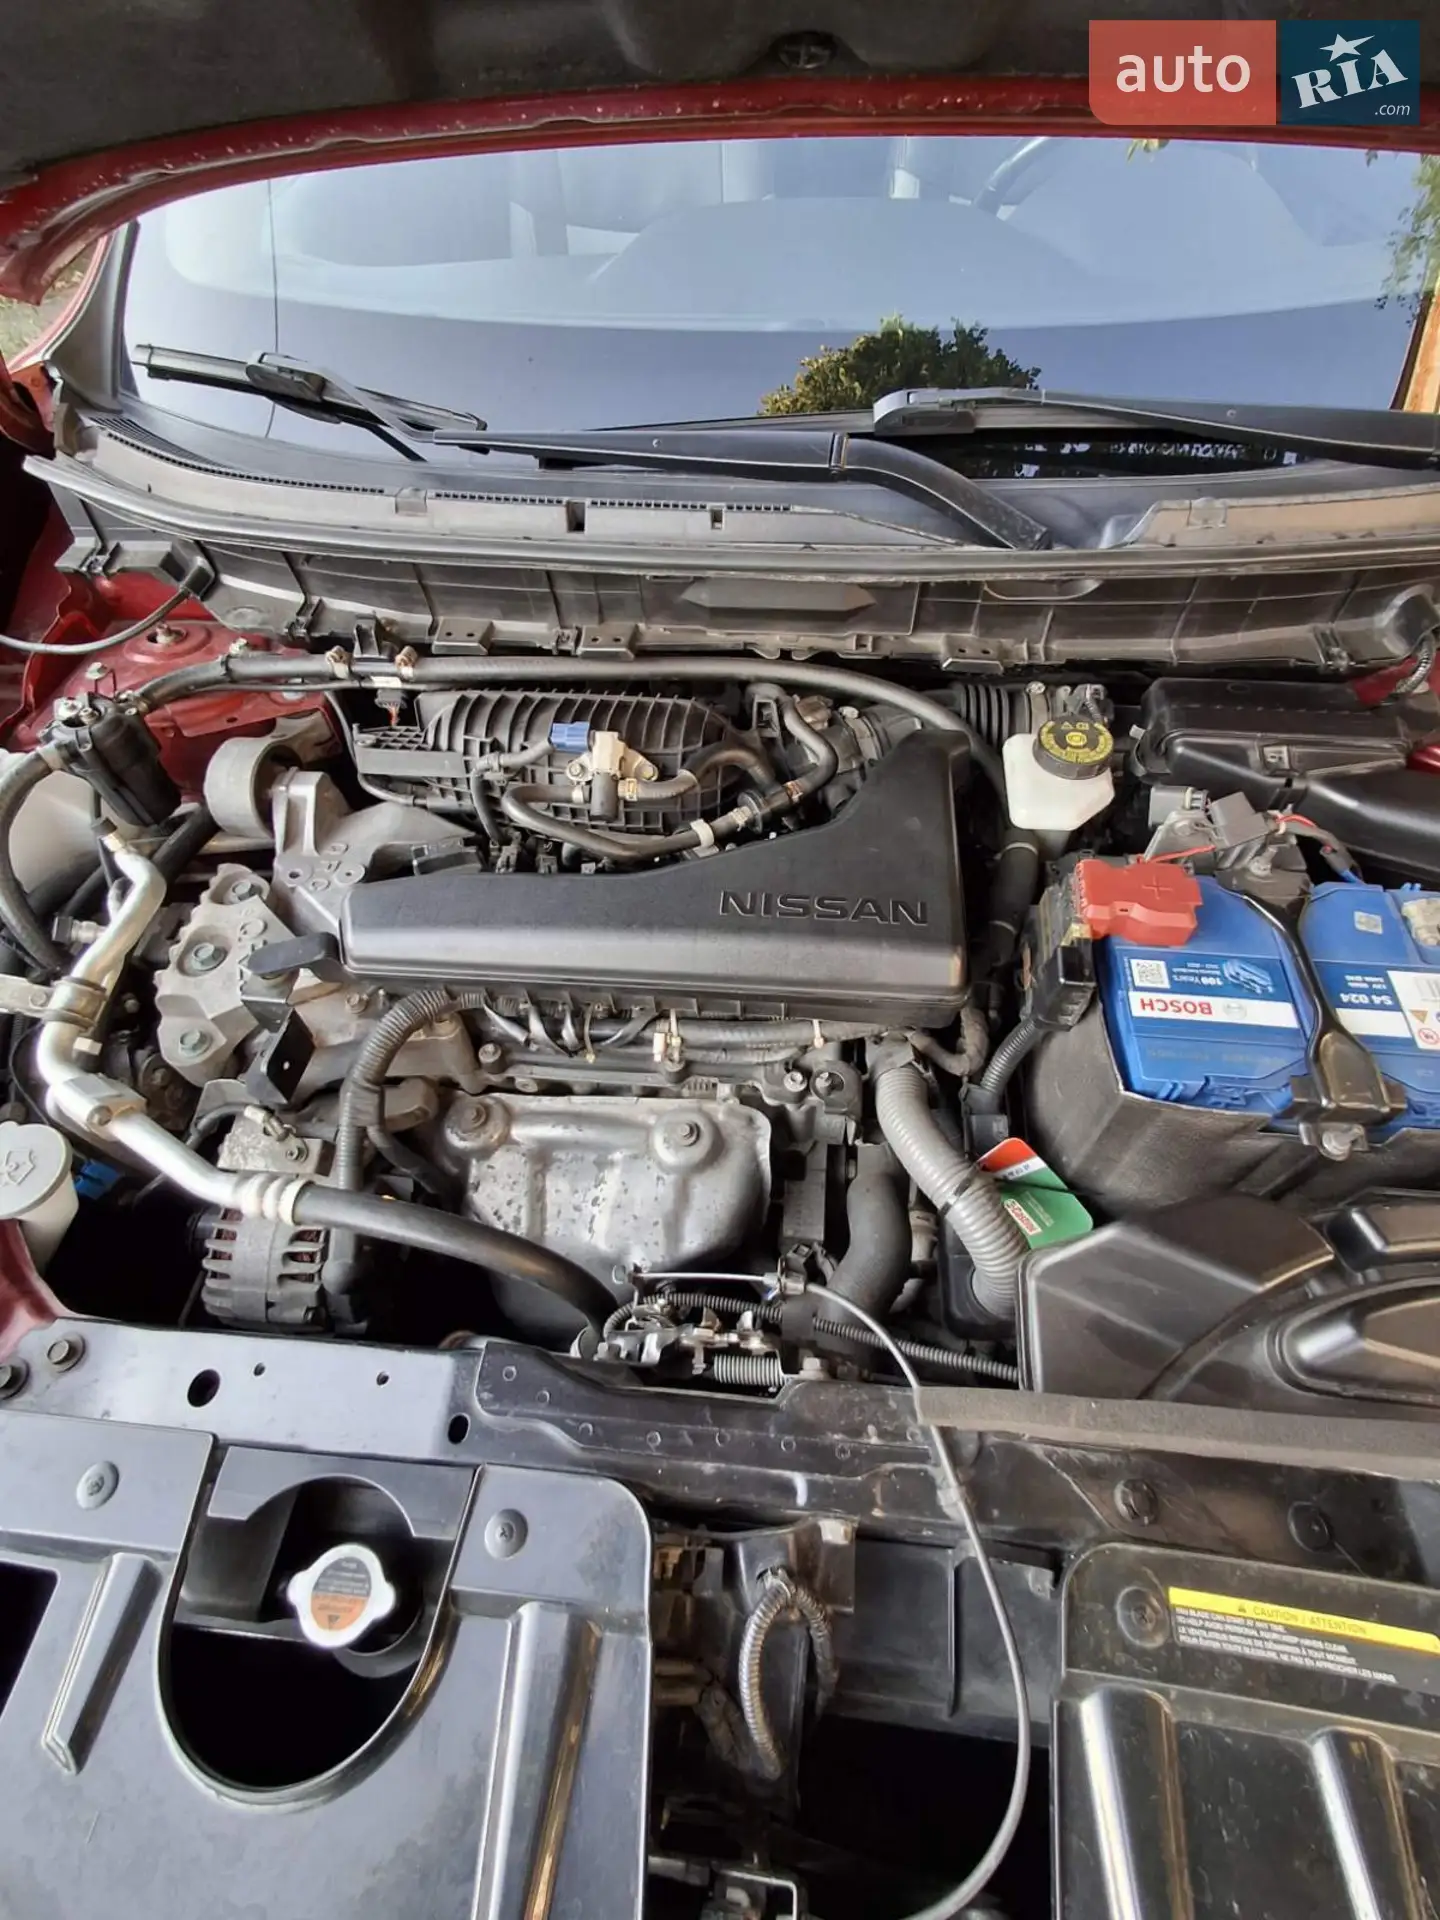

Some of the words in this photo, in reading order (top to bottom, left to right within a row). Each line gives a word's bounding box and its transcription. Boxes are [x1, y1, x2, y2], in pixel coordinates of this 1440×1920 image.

[719, 889, 928, 926] NISSAN
[1140, 998, 1213, 1016] BOSCH
[1253, 1606, 1298, 1622] CAUTION
[1311, 1617, 1367, 1635] ATTENTION
